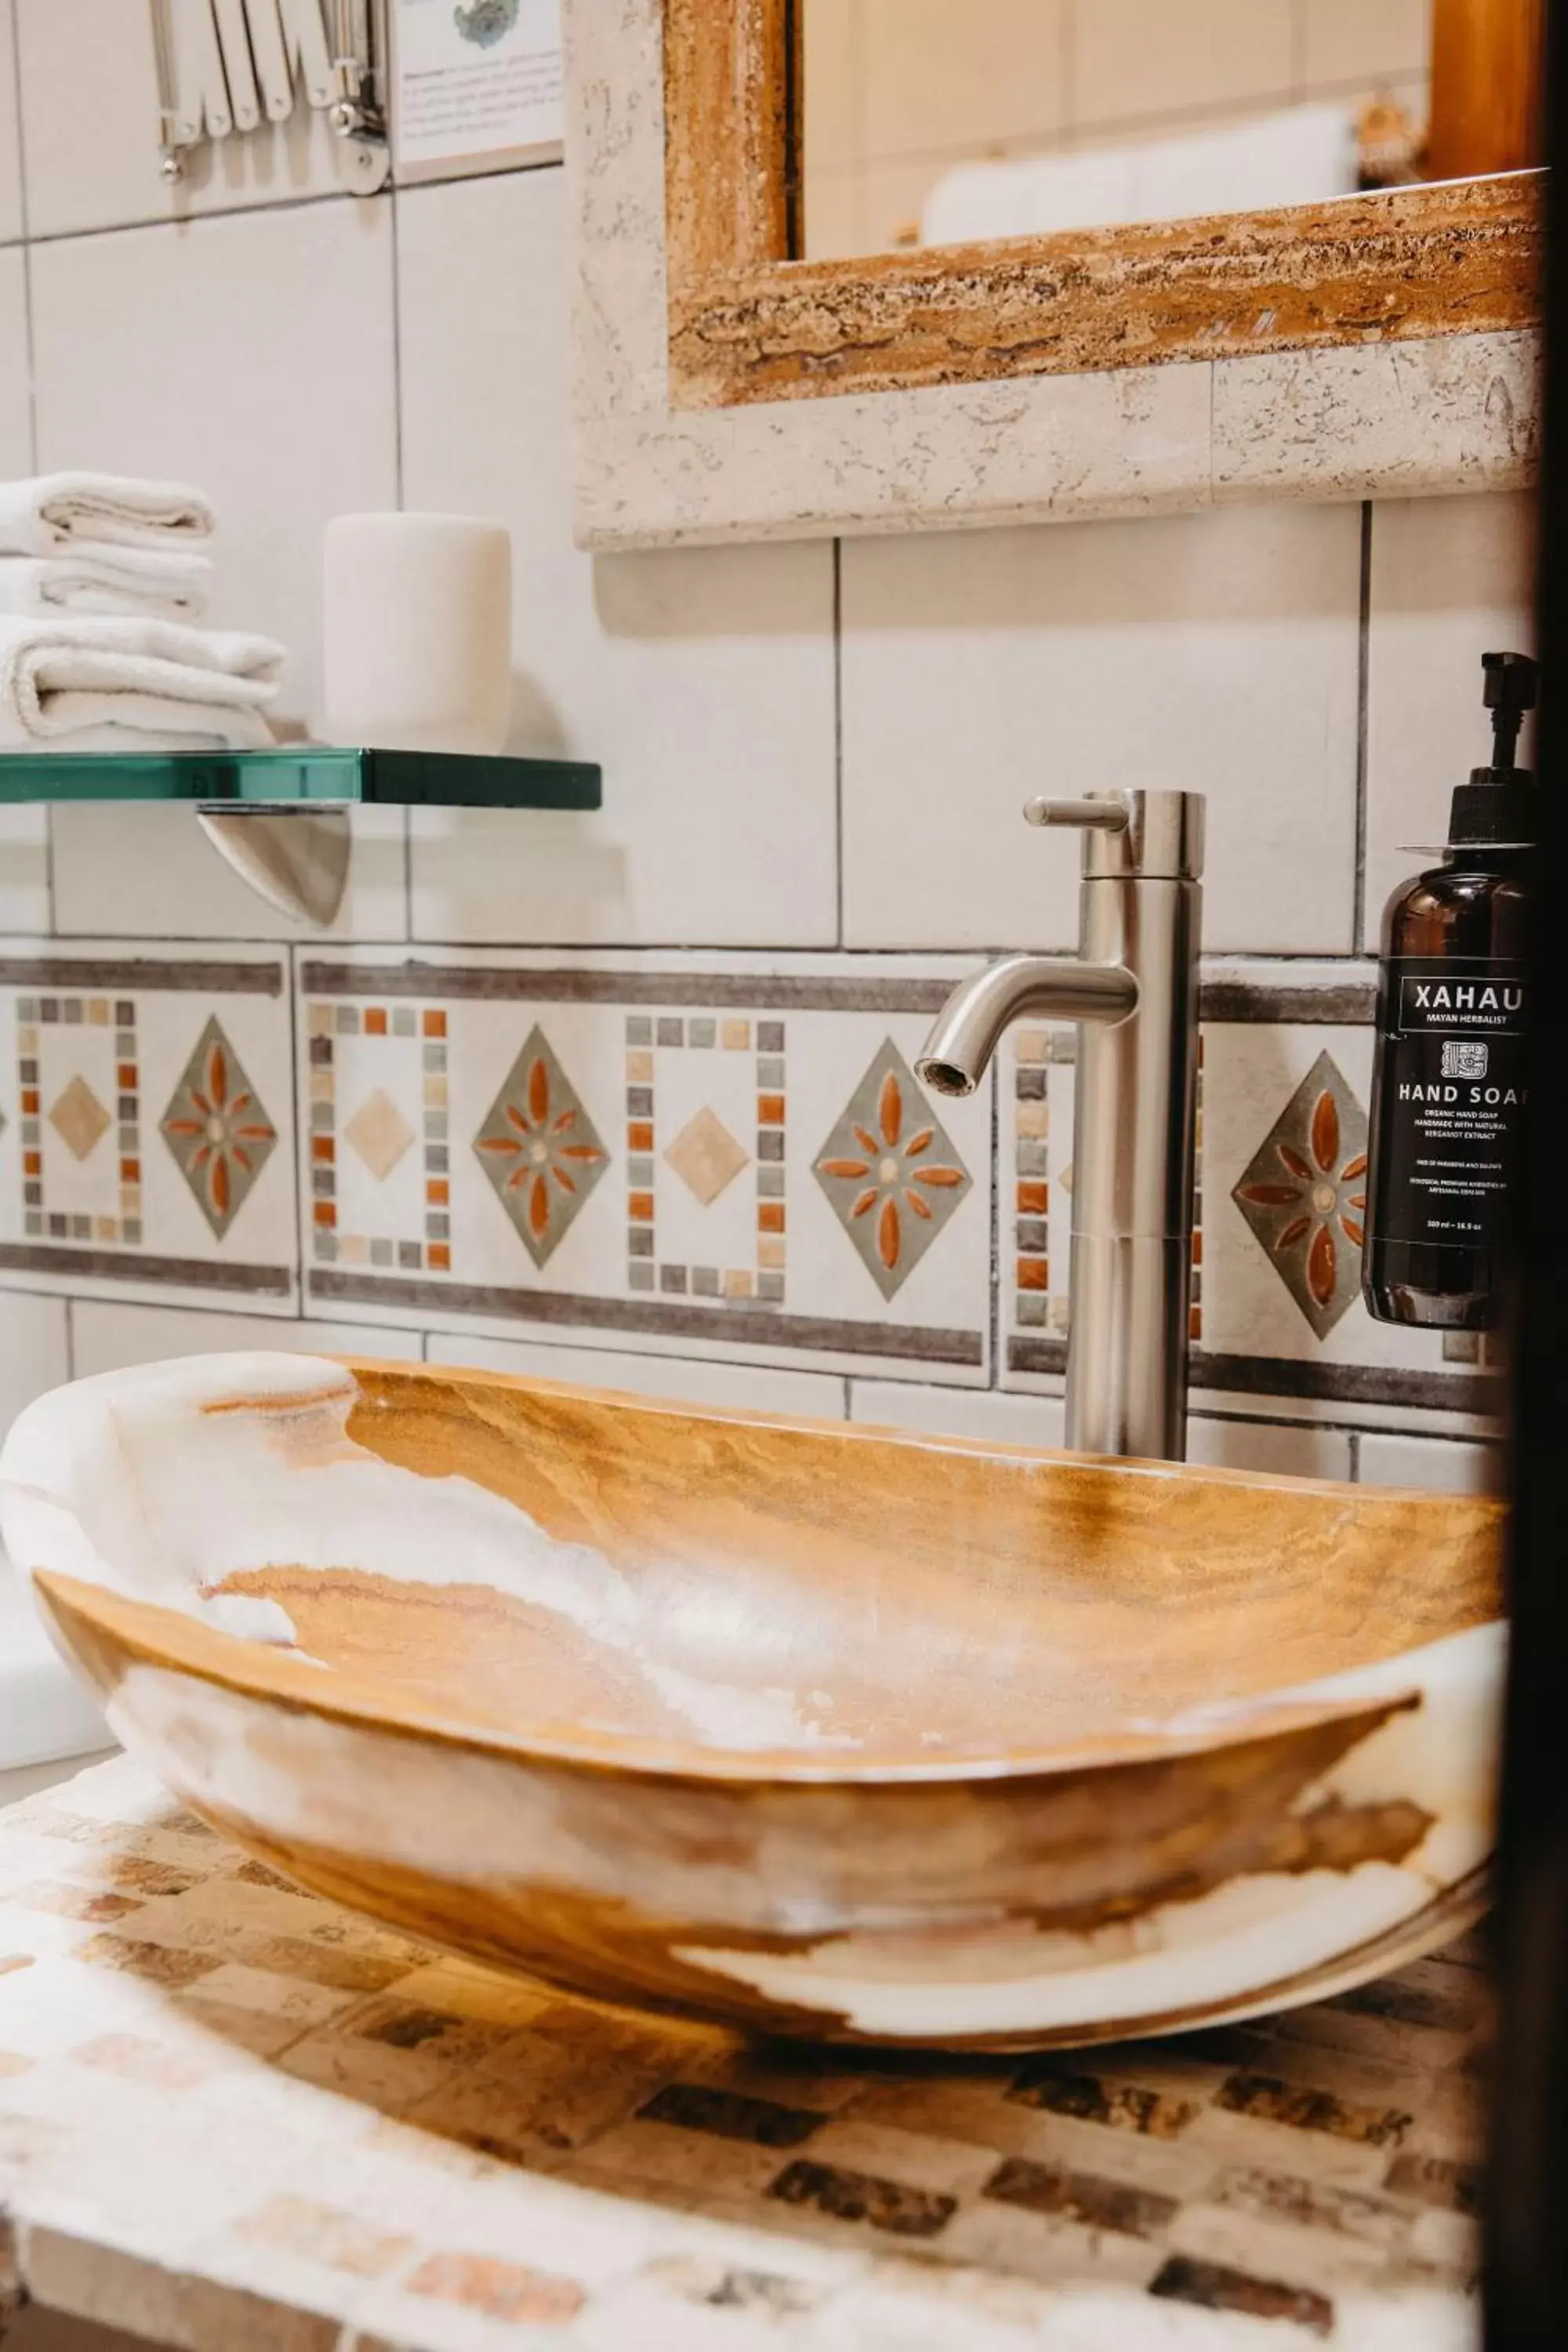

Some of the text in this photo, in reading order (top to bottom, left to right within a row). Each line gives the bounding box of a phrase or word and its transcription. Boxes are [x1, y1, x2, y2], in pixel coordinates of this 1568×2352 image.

[1415, 985, 1523, 1011] XAHAU
[1427, 1014, 1507, 1025] MAYAN HERBALIST
[1399, 1083, 1458, 1102] HAND
[1414, 1119, 1507, 1130] HANDMADE WITH NATURAL
[1425, 1129, 1496, 1140] BERGAMOT EXTRACT
